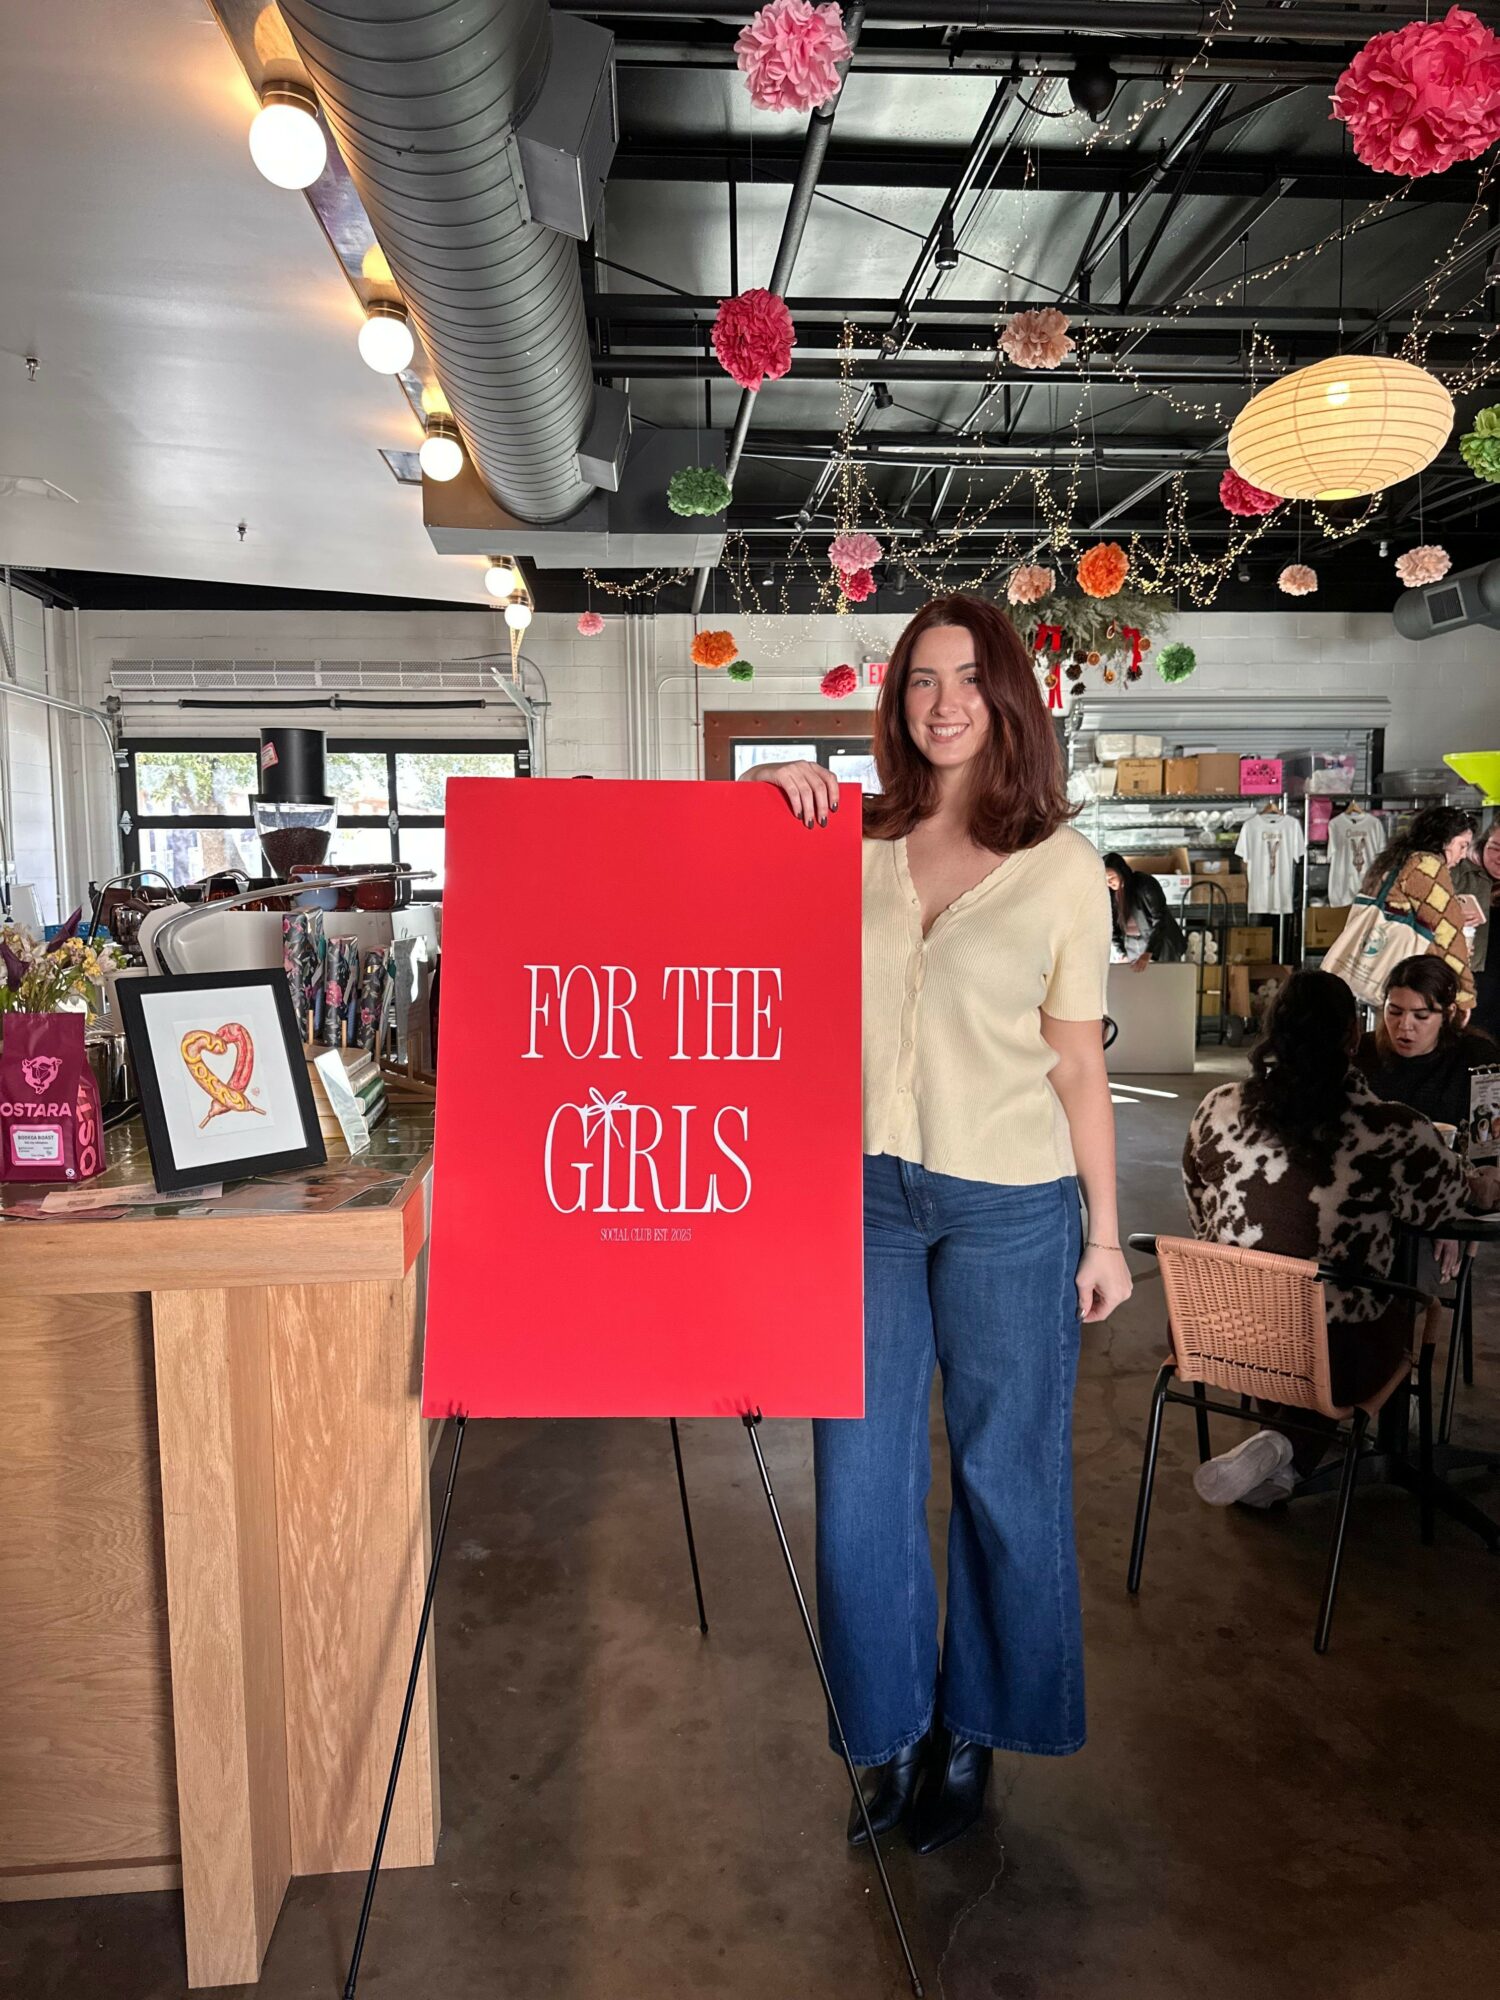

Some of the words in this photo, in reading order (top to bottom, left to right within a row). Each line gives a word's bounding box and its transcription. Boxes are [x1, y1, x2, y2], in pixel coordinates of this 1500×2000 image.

[521, 965, 643, 1060] FOR
[662, 966, 782, 1060] THE
[0, 1102, 72, 1117] OSTARA
[544, 1102, 752, 1214] GIRLS
[600, 1227, 628, 1241] SOCIAL
[630, 1227, 652, 1241] CLUB
[671, 1227, 692, 1241] 2025
